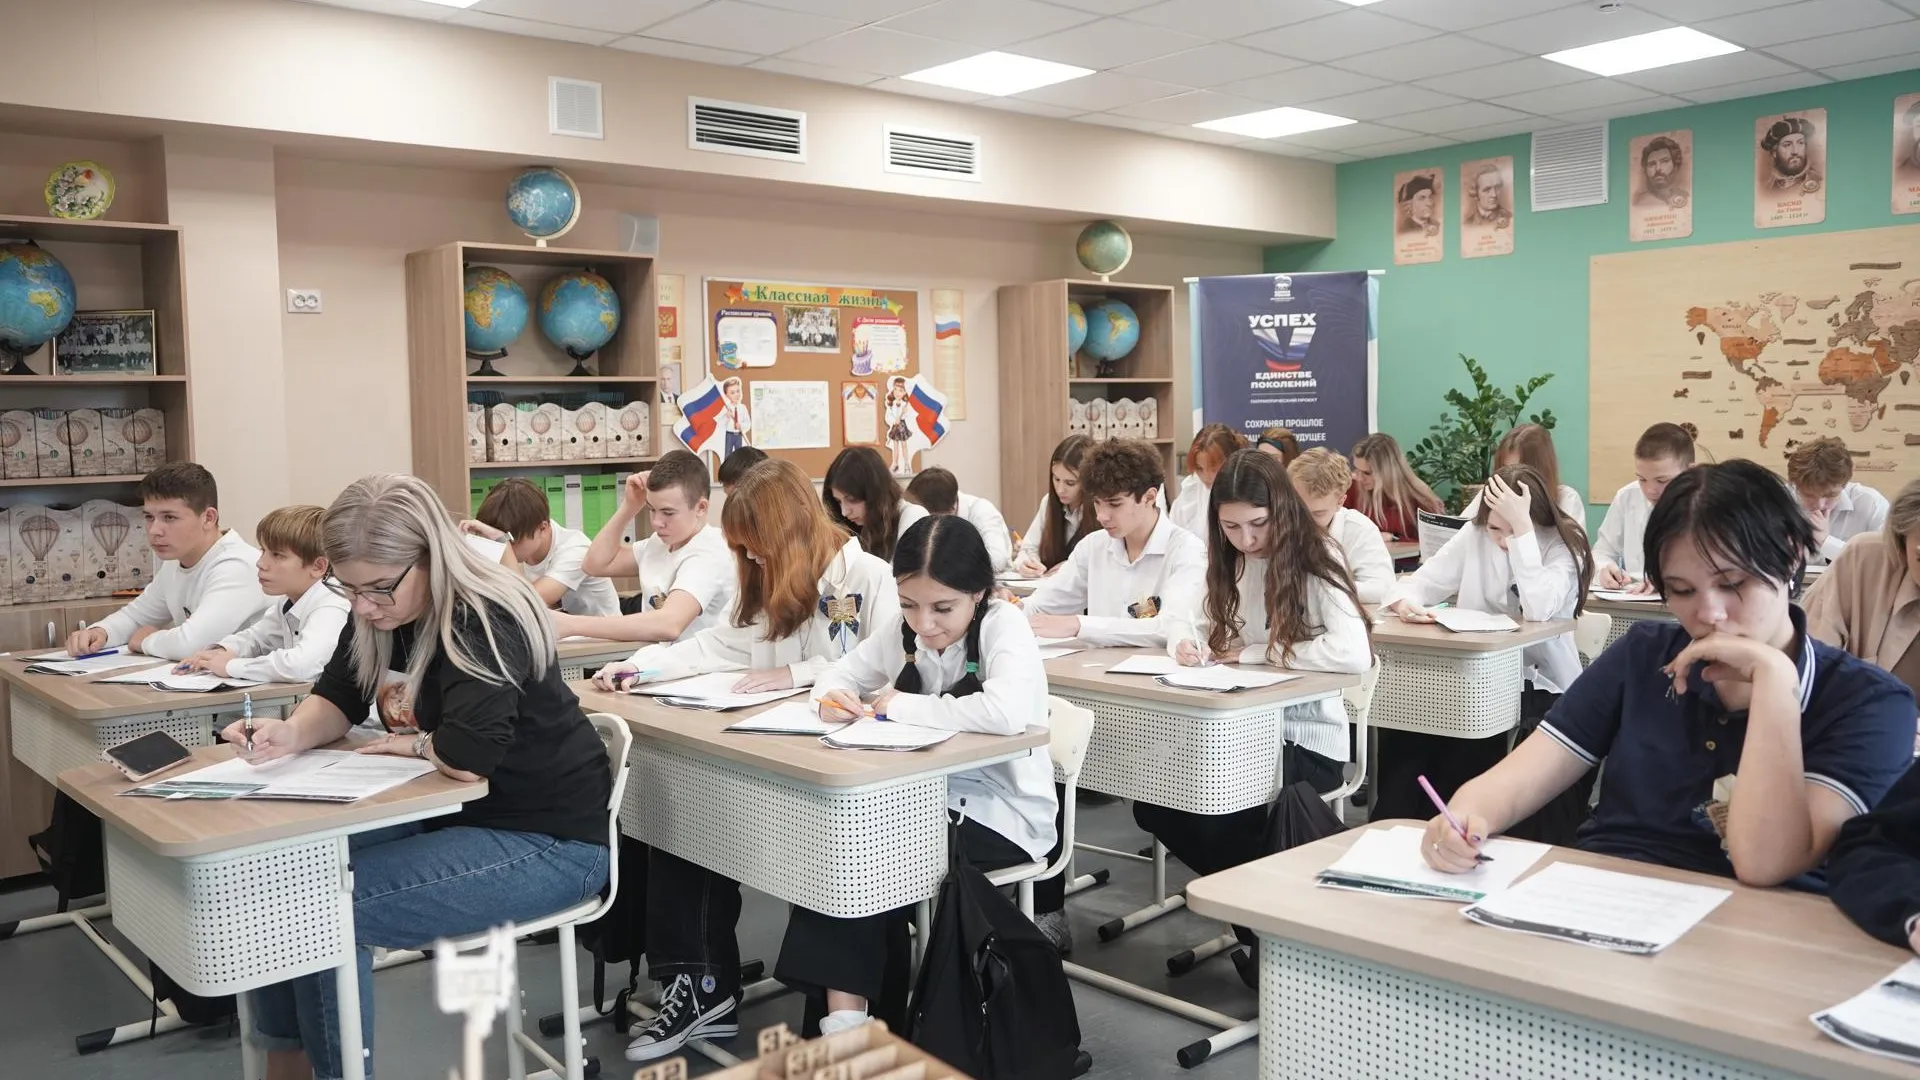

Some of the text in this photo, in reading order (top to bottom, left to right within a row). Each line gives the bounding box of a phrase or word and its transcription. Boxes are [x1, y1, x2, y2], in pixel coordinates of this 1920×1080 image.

[756, 285, 883, 306] Классная жизнь
[1248, 313, 1317, 328] УСПЕХ
[1255, 371, 1312, 380] ЕДИНСТВЕ
[1250, 379, 1317, 389] ПОКОЛЕНИЙ
[1245, 418, 1324, 428] СОХРАНЯЯ ПРОШЛОЕ
[1294, 433, 1327, 442] УДУЩЕЕ
